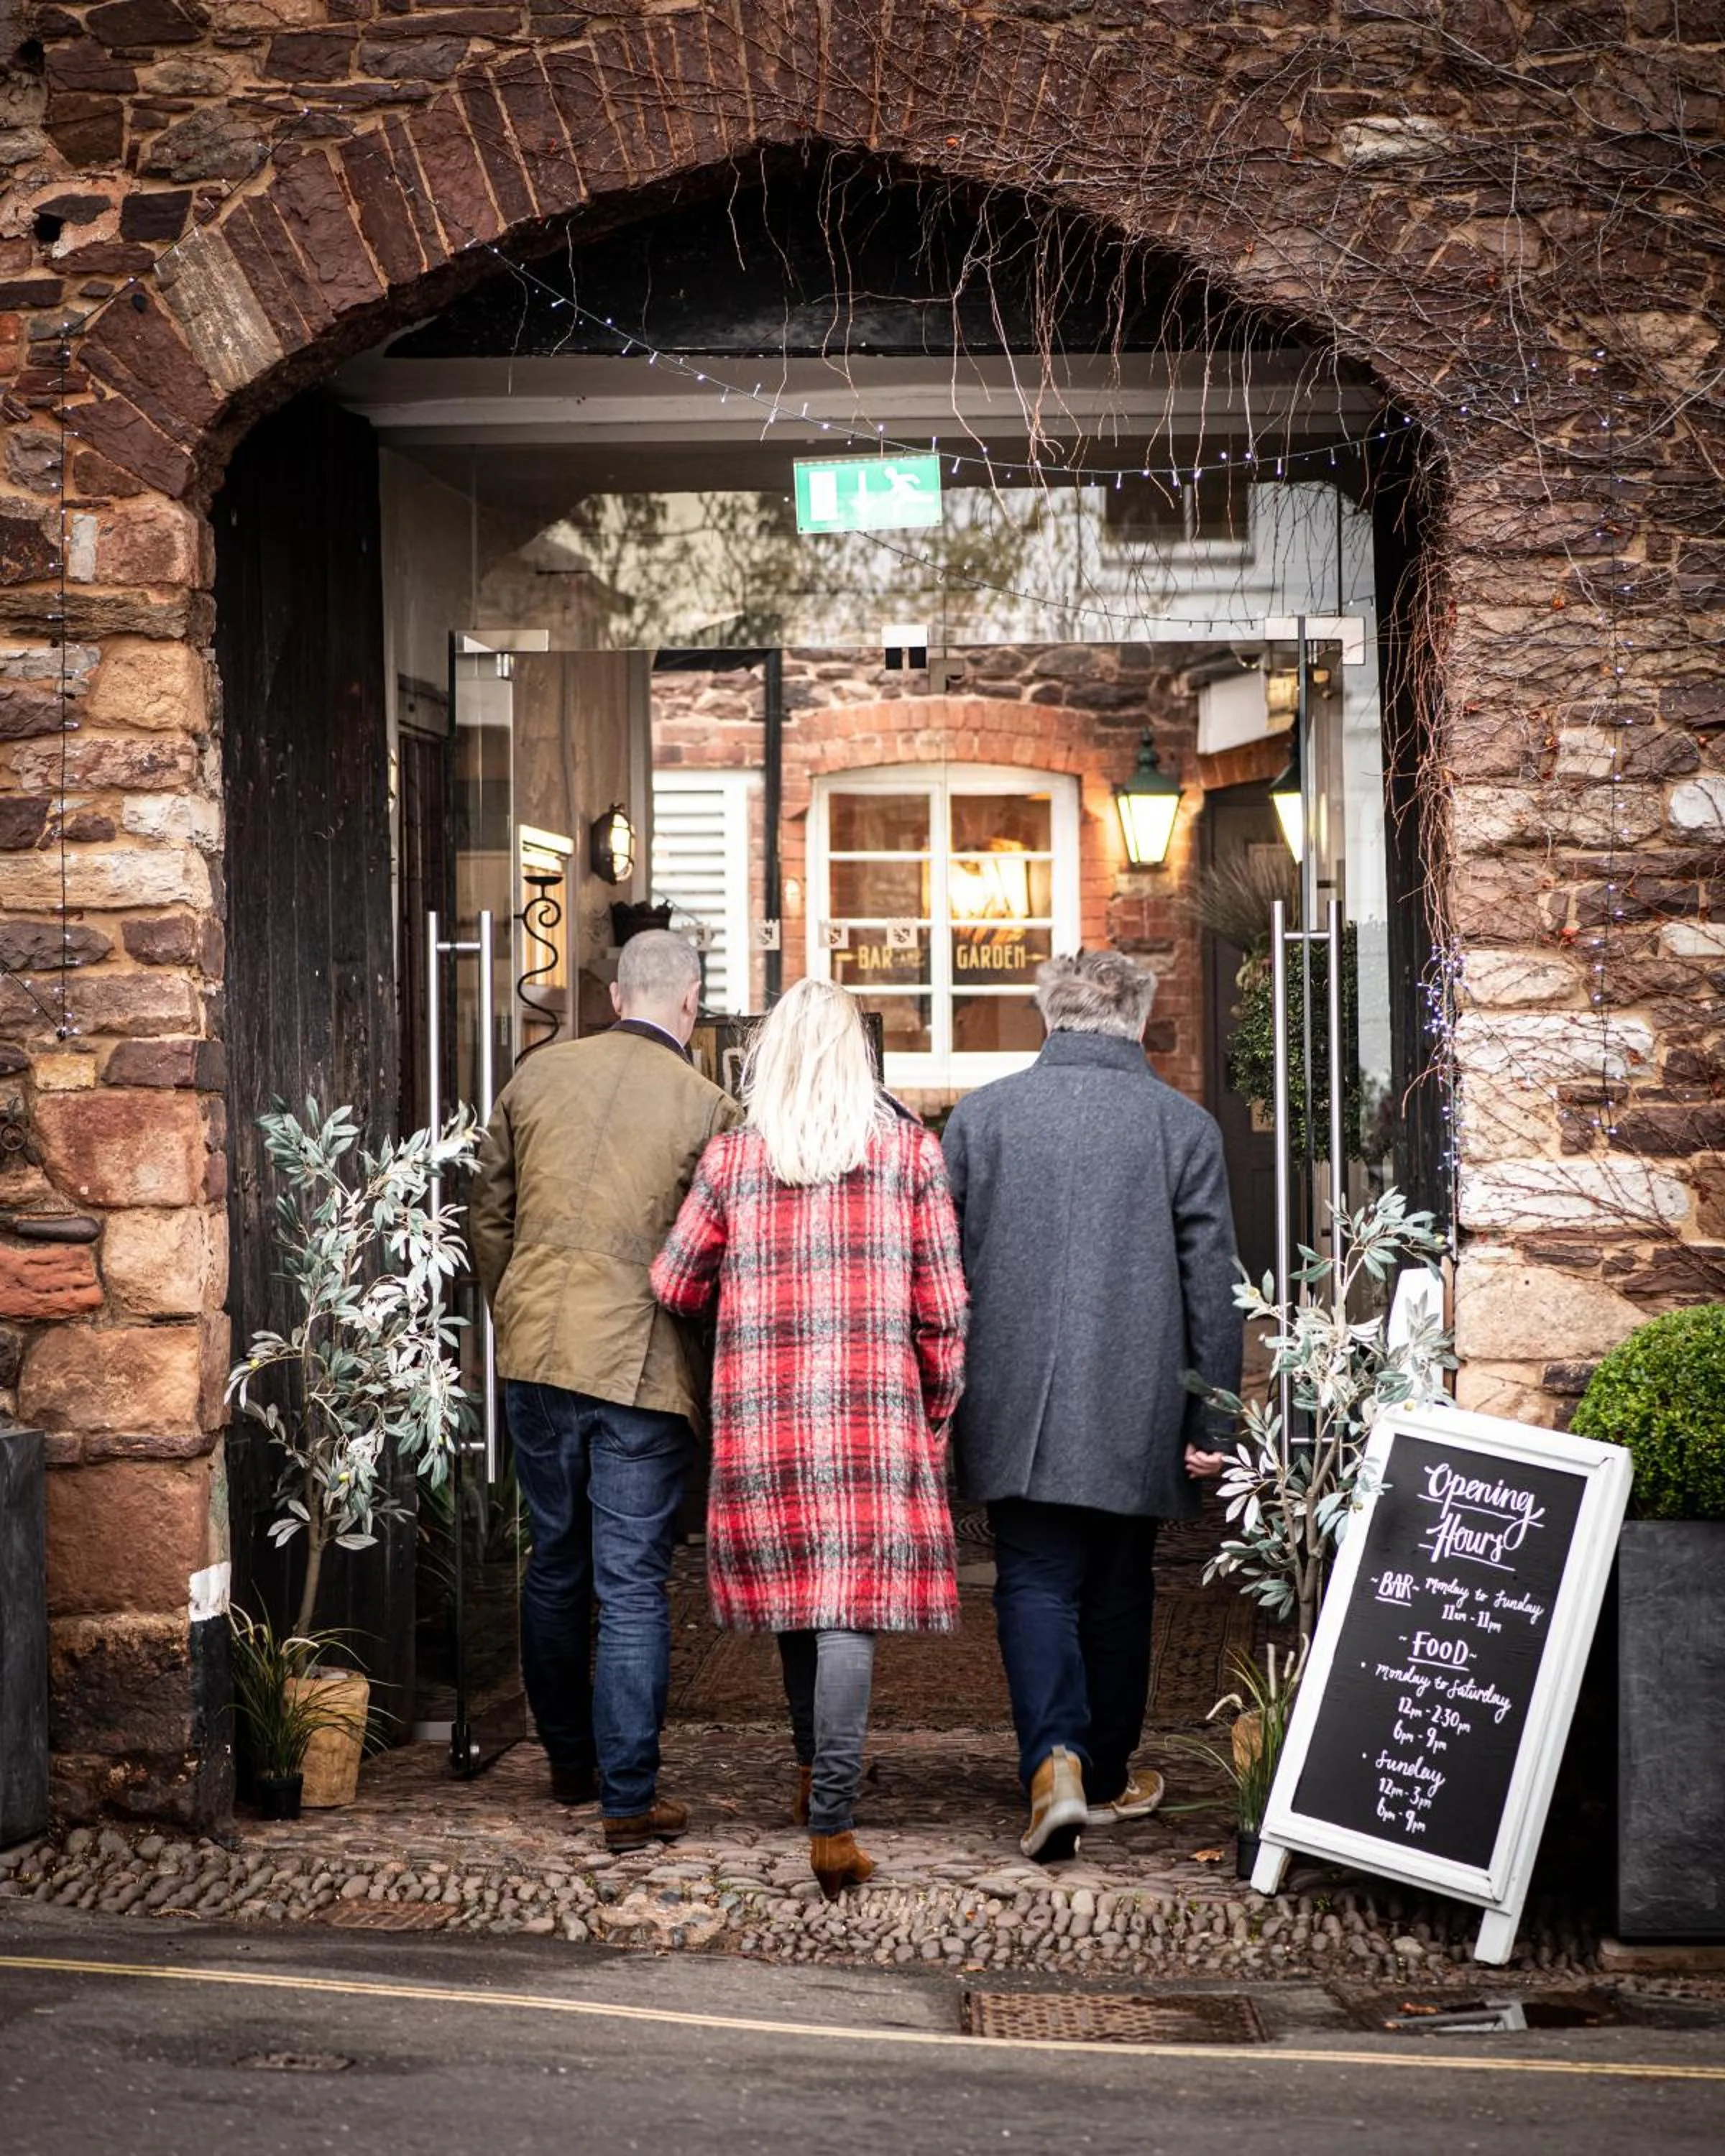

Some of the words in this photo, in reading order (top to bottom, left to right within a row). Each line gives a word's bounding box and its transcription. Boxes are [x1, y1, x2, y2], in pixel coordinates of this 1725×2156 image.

[857, 944, 893, 969] BAR
[957, 943, 1026, 969] GARDEN
[1425, 1463, 1545, 1550] Opening
[1426, 1513, 1504, 1562] Hours
[1378, 1571, 1414, 1599] BAR
[1475, 1588, 1488, 1602] to
[1494, 1590, 1545, 1625] Sunday
[1412, 1631, 1468, 1664] FOOD
[1434, 1676, 1449, 1690] to
[1447, 1678, 1512, 1724] Saturday
[1375, 1749, 1446, 1798] Sunday
